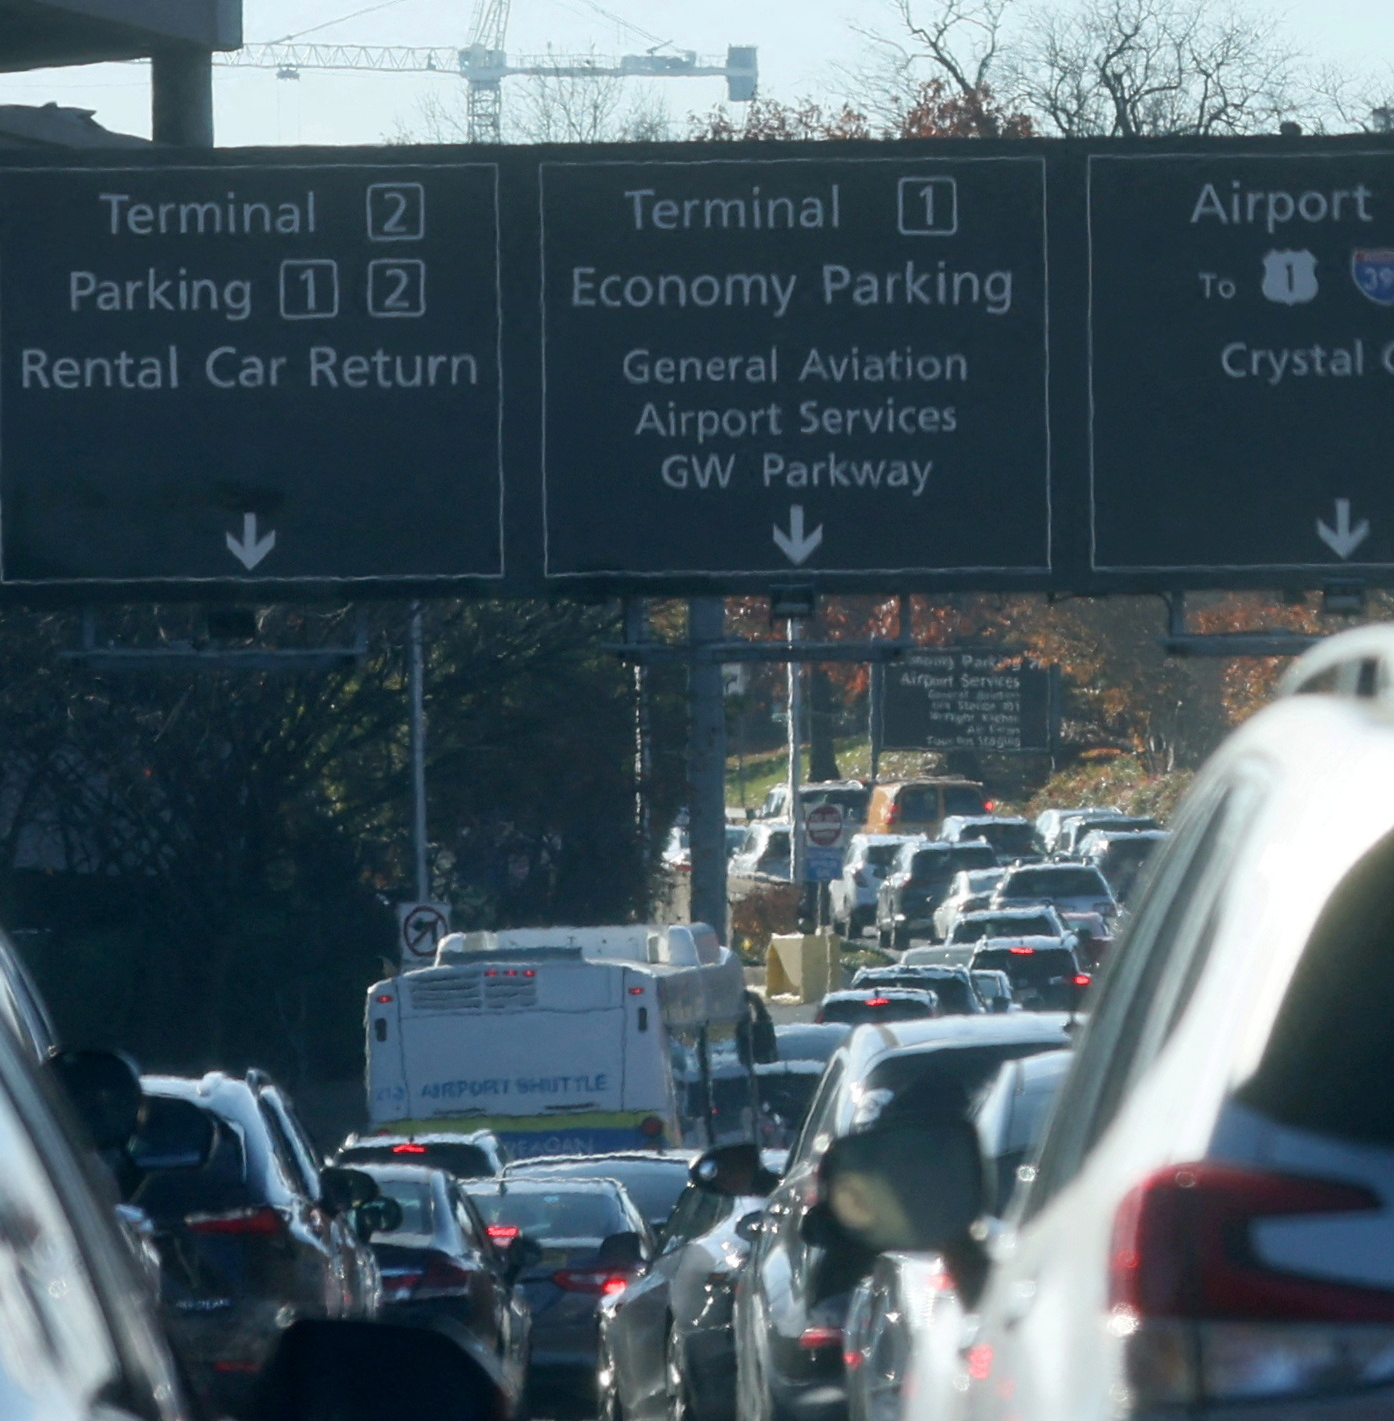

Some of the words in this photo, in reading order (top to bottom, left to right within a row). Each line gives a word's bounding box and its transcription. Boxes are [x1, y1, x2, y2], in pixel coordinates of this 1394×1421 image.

[99, 190, 316, 235] Terminal
[383, 191, 407, 233] 2
[623, 183, 840, 230] Terminal
[1190, 180, 1373, 234] Airport
[69, 267, 252, 321] Parking
[383, 267, 410, 308] 2
[571, 266, 797, 318] Economy
[822, 260, 1013, 315] Parking
[1198, 271, 1237, 299] To
[21, 344, 179, 390] Rental
[205, 345, 287, 389] Car
[309, 345, 478, 388] Return
[622, 346, 778, 384] General
[798, 346, 968, 382] Aviation
[1220, 339, 1364, 385] Crystal
[634, 400, 783, 445] Airport
[799, 397, 957, 435] Services
[661, 453, 736, 489] GW
[762, 451, 933, 497] Parkway
[901, 671, 954, 689] Airport
[961, 672, 1020, 689] Services
[421, 1079, 509, 1099] AIRPORT
[517, 1073, 607, 1095] SHUTTLE
